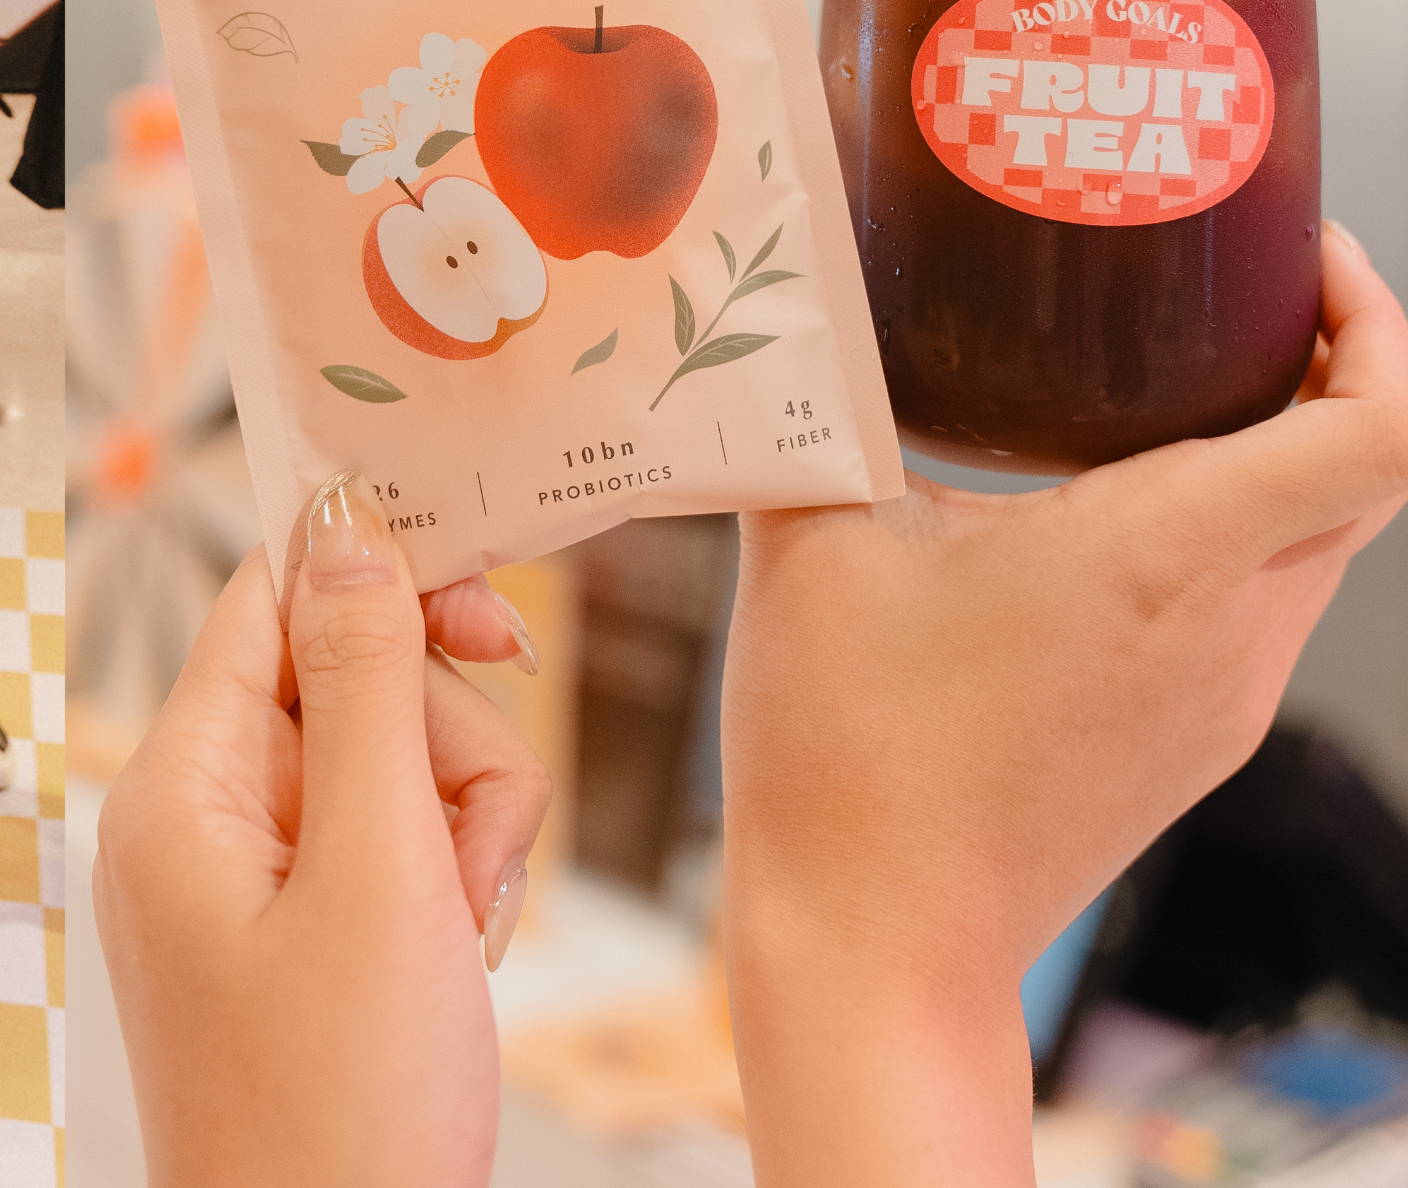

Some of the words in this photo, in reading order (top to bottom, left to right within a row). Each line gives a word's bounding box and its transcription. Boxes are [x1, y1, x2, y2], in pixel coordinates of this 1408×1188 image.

[961, 56, 1236, 122] FRUIT
[1003, 114, 1192, 175] TEA
[784, 400, 813, 420] 4g
[776, 427, 832, 453] FIBER
[563, 441, 634, 467] 10bn
[538, 465, 673, 506] PROBIOTICS
[387, 512, 437, 533] YMES
